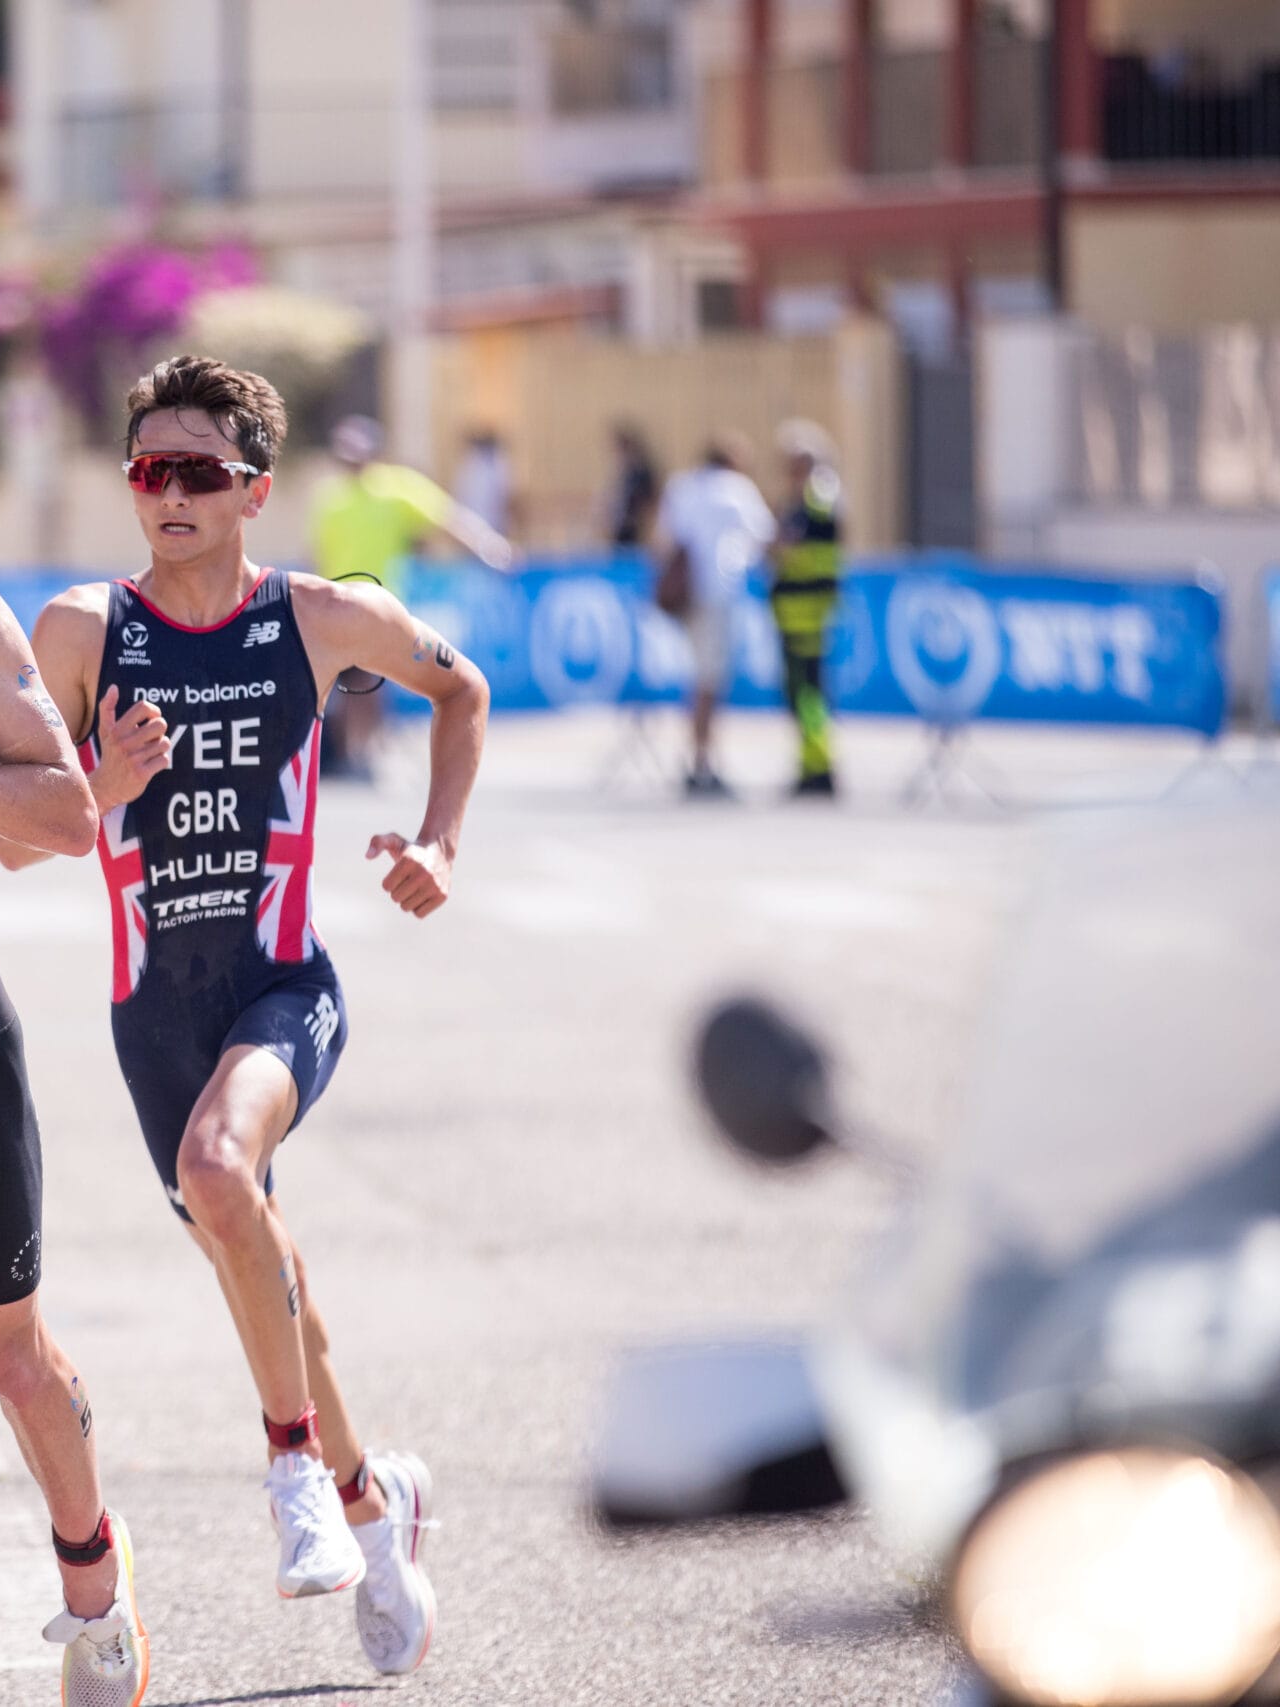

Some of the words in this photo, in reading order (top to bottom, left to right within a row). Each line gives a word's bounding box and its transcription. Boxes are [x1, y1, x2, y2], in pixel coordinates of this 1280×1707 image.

[118, 656, 151, 665] Triathlon
[123, 649, 146, 657] World
[133, 687, 179, 703] new
[184, 680, 276, 704] balance
[167, 788, 241, 837] GBR
[150, 850, 258, 886] HUUB
[152, 888, 251, 918] TREK
[157, 912, 205, 930] FACTORY
[205, 906, 247, 919] RACING
